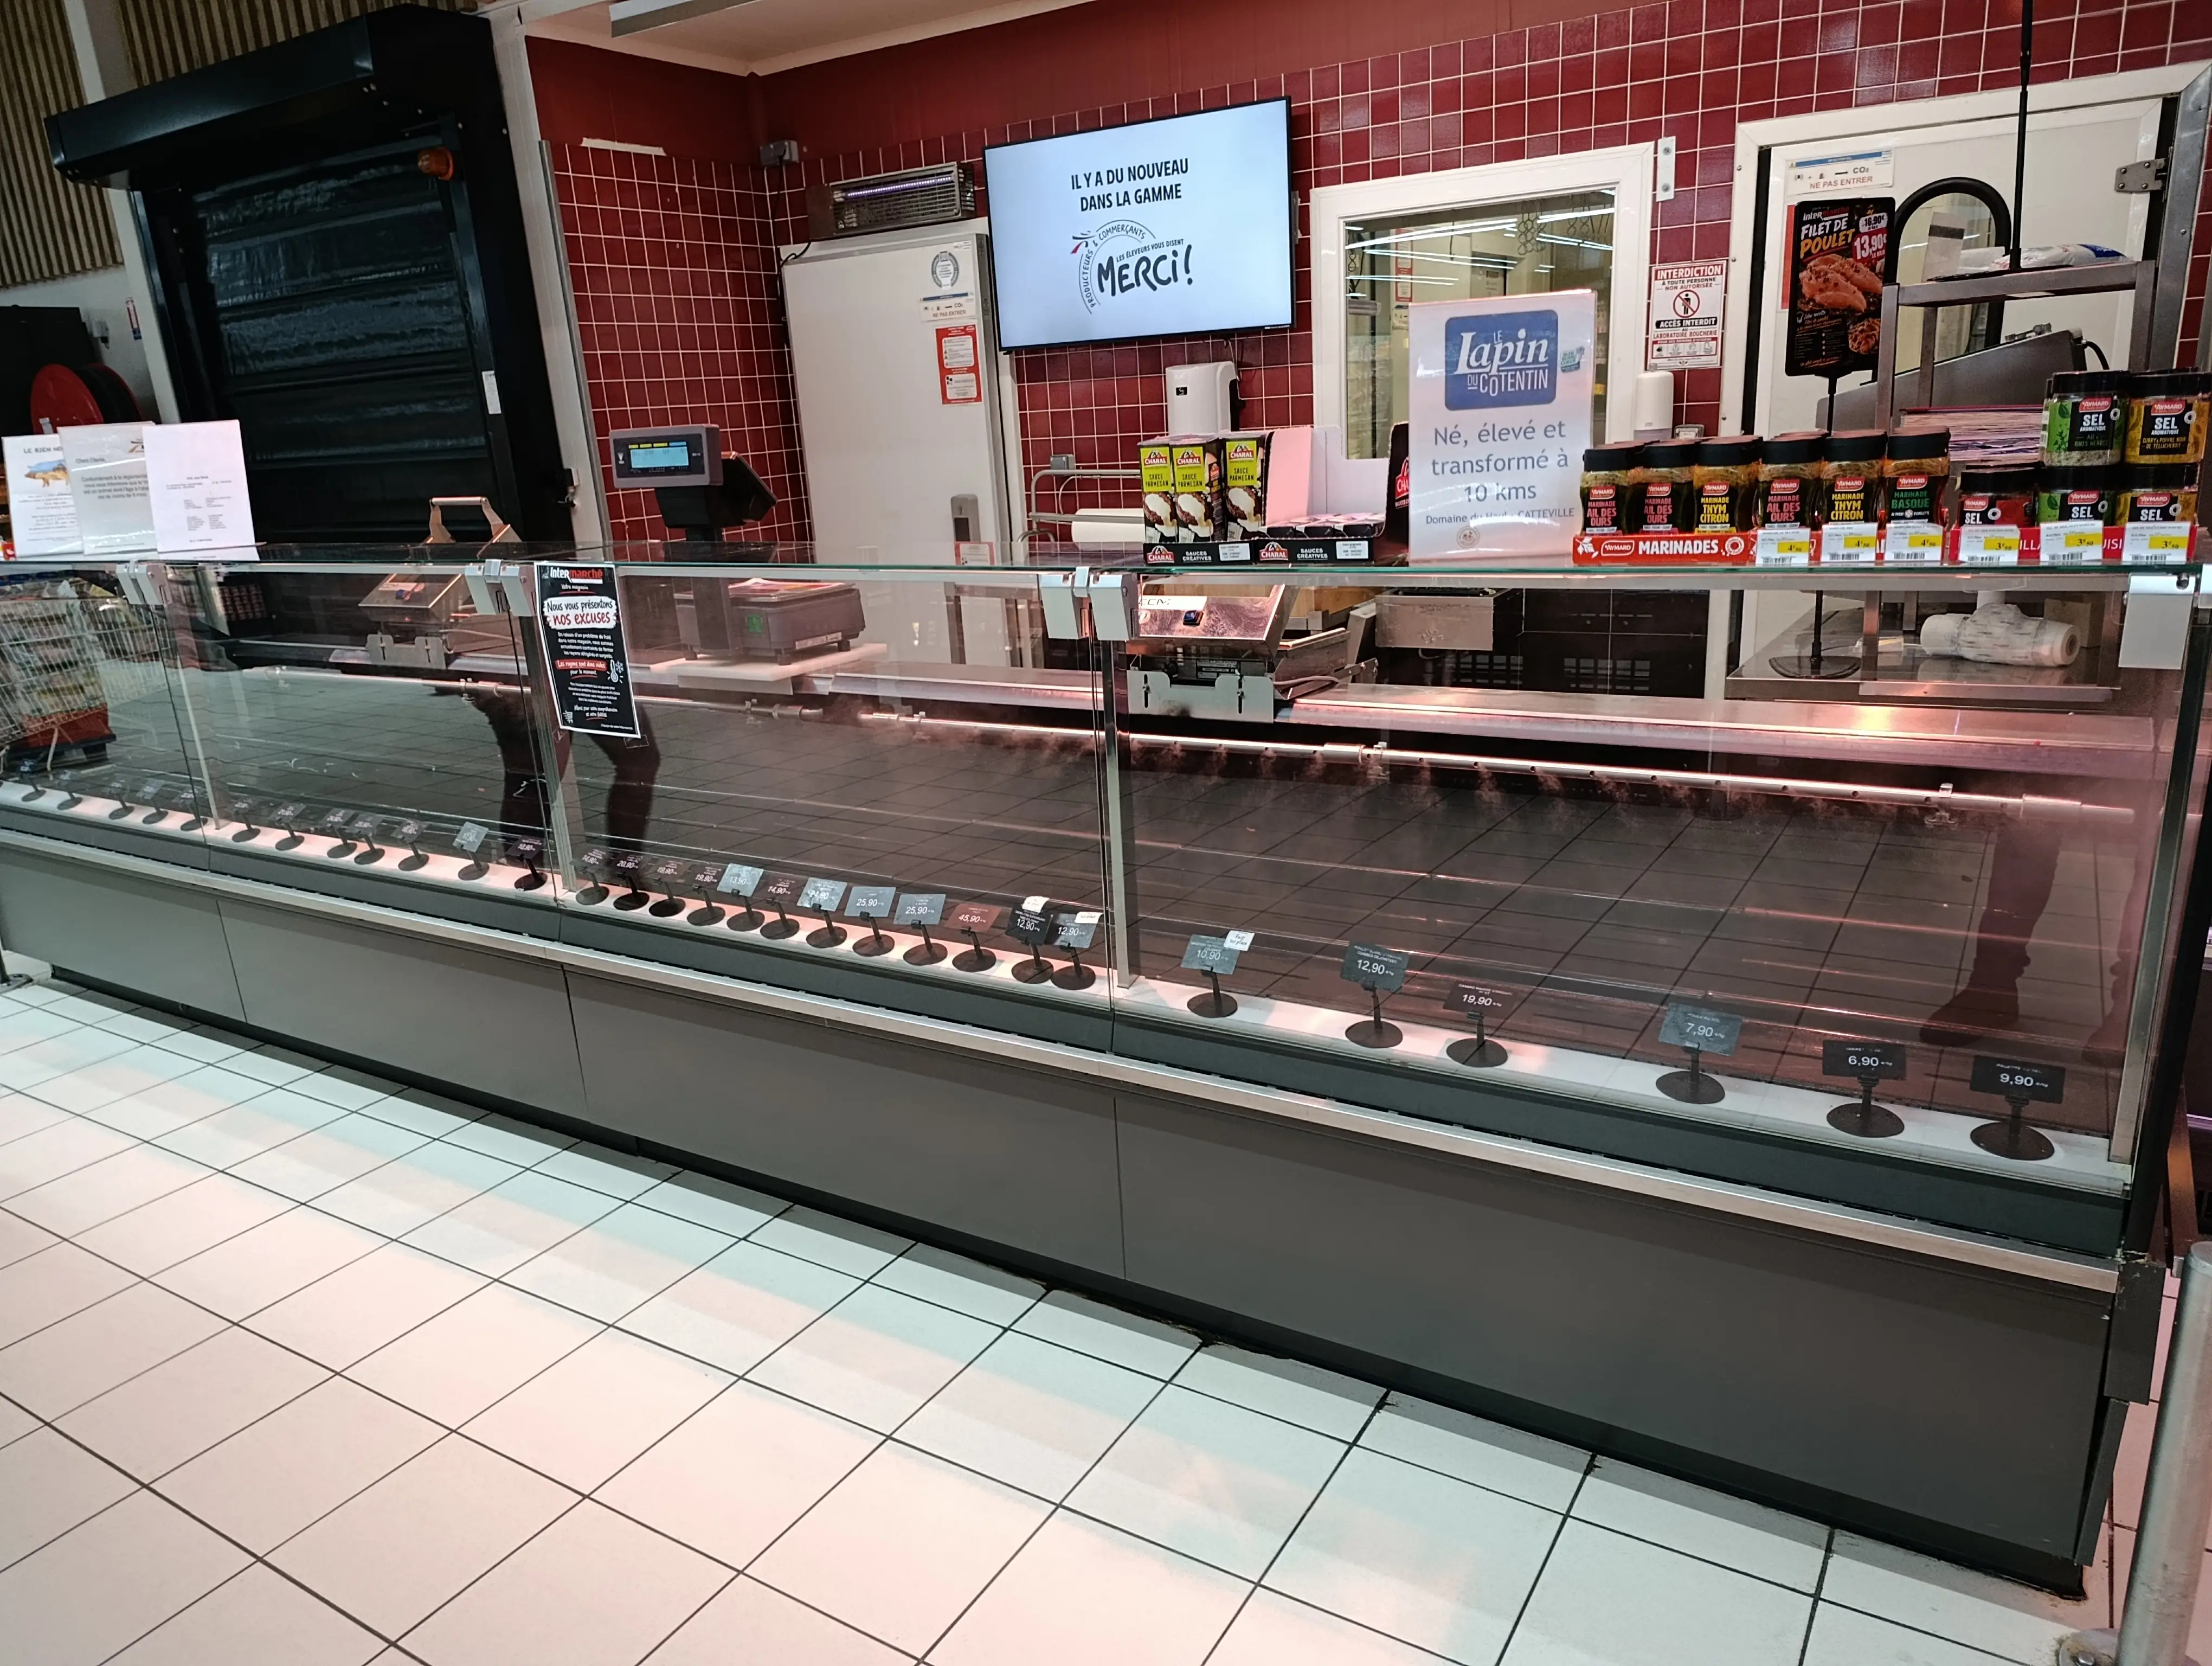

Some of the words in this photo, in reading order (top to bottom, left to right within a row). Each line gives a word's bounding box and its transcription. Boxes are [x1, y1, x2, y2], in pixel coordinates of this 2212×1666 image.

[1071, 175, 1082, 189] IL
[1084, 172, 1091, 188] Y
[1095, 171, 1103, 187] A
[1107, 168, 1124, 184] DU
[1128, 158, 1188, 181] NOUVEAU
[1823, 180, 1838, 188] PAS
[1840, 176, 1873, 185] ENTRER
[1081, 193, 1113, 212] DANS
[1116, 191, 1131, 207] LA
[1134, 184, 1181, 204] GAMME
[1801, 220, 1831, 241] FILET
[1834, 217, 1848, 232] DE
[1800, 228, 1856, 259] POULET
[1854, 233, 1887, 260] 13,90€
[1116, 254, 1125, 262] LES
[1126, 245, 1150, 258] ÉLEVEURS
[1152, 241, 1165, 250] VOUS
[1166, 239, 1184, 247] DISENT
[1082, 249, 1096, 307] PRODUCTEURS
[1099, 224, 1146, 241] COMMERÇANTS
[1657, 265, 1721, 280] INTERDICTION
[1660, 319, 1681, 328] ACCÈS
[1683, 318, 1716, 326] INTERDIT
[1494, 330, 1502, 344] LE
[1455, 328, 1548, 375] Lapin
[1468, 375, 1478, 387] DU
[1480, 369, 1548, 397] COTENTIN
[2083, 414, 2105, 426] SEL
[2155, 416, 2177, 430] SEL
[1434, 425, 1468, 448] Né,
[1478, 419, 1535, 443] élevé
[1544, 421, 1566, 438] et
[1432, 449, 1548, 475] transformé
[1557, 448, 1568, 467] à
[1397, 479, 1409, 492] CHA
[1464, 484, 1487, 502] 10
[1496, 482, 1536, 501] kms
[1644, 505, 1655, 514] AIL
[1657, 505, 1672, 514] DES
[1703, 504, 1726, 514] THYM
[1766, 503, 1780, 512] AIL
[1783, 502, 1800, 512] DES
[1835, 501, 1861, 511] THYM
[1891, 498, 1930, 509] BASQUE
[1426, 514, 1467, 524] Domaine
[1518, 508, 1575, 519] CATTEVILLE
[1587, 508, 1599, 517] AIL
[1601, 508, 1617, 517] DES
[1647, 514, 1667, 523] OURS
[1700, 513, 1729, 523] CITRON
[1771, 512, 1795, 522] OURS
[1831, 510, 1863, 521] CITRON
[1965, 512, 1982, 524] SEL
[2072, 507, 2093, 518] SEL
[2140, 509, 2163, 521] SEL
[1591, 517, 1611, 526] OURS
[1638, 540, 1719, 554] MARINADES
[2019, 539, 2041, 550] ILL
[550, 567, 603, 581] Intermarché
[547, 600, 563, 612] Nous
[564, 602, 578, 610] vous
[581, 598, 613, 612] présentons
[553, 613, 571, 626] nos
[575, 612, 610, 624] excuses
[695, 874, 713, 882] 19,90
[768, 886, 786, 894] 14,90
[856, 898, 878, 907] 25,90
[905, 906, 928, 915] 25,90
[959, 914, 981, 923] 45,90
[1017, 918, 1034, 931] 12,90
[1058, 926, 1079, 936] 12,90
[1197, 949, 1220, 960] 10,90
[1357, 959, 1385, 975] 12,90
[1463, 994, 1493, 1005] 19,90
[1687, 1022, 1714, 1037] 7,90
[1848, 1055, 1879, 1066] 6,90
[1999, 1073, 2034, 1087] 9,90
